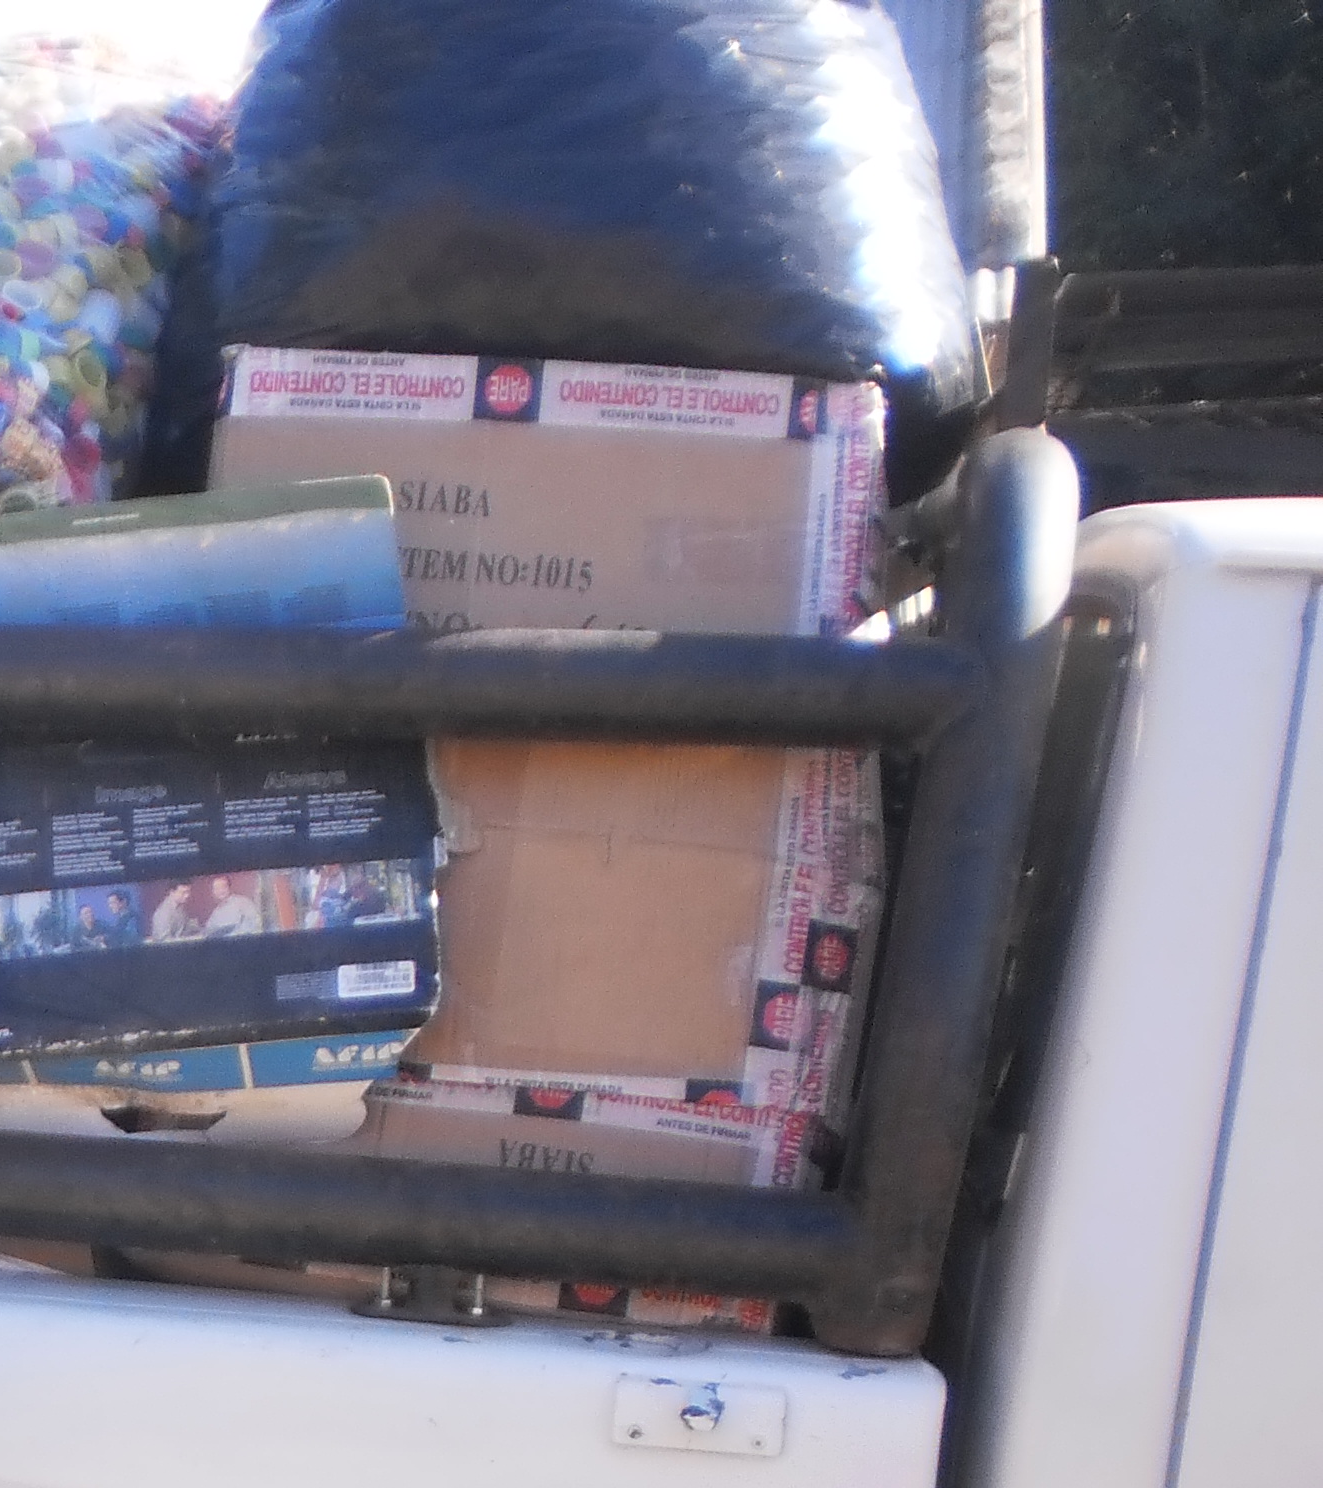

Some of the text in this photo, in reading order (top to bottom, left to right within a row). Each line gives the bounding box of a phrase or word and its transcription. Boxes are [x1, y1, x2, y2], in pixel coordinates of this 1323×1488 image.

[250, 370, 464, 399] CONTROLE EL CONTENIDO
[488, 375, 530, 403] PARE
[559, 379, 658, 407] CONTENIDO
[662, 386, 684, 410] EL
[687, 387, 779, 415] CONTROLE
[398, 479, 491, 517] SIABA
[398, 545, 592, 592] TEM NO:1015
[263, 769, 348, 790] Always
